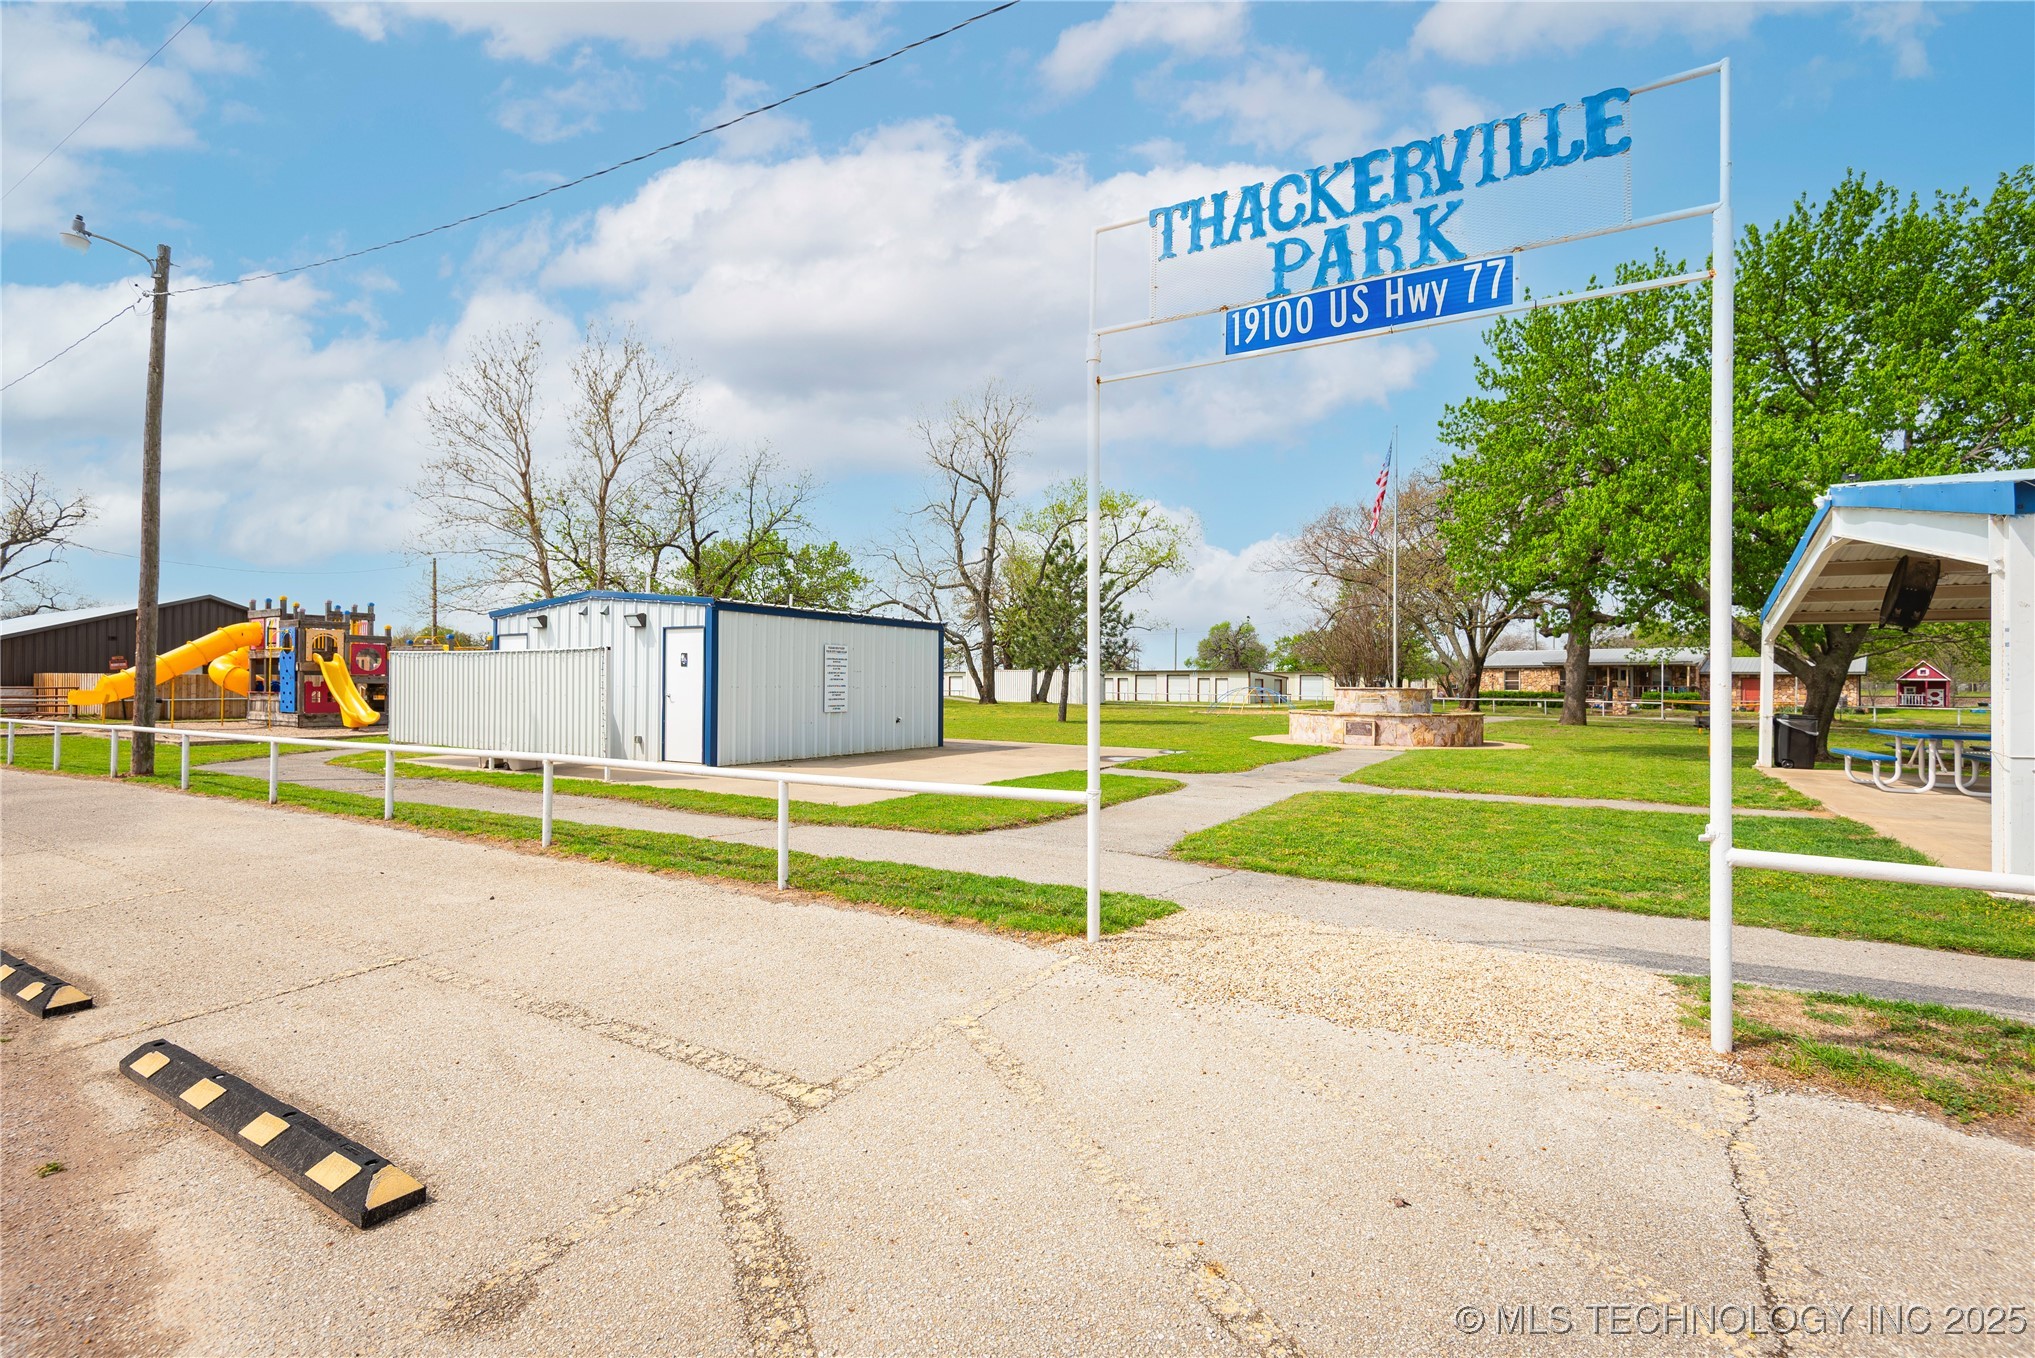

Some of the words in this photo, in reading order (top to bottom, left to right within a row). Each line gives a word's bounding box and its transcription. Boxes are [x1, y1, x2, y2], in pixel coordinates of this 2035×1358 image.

[1149, 87, 1632, 261] THACKERVILLE
[1266, 199, 1466, 299] PARK
[1232, 297, 1314, 346] 19100
[1330, 284, 1369, 328] US
[1385, 277, 1449, 318] Hwy
[1464, 258, 1506, 304] 77
